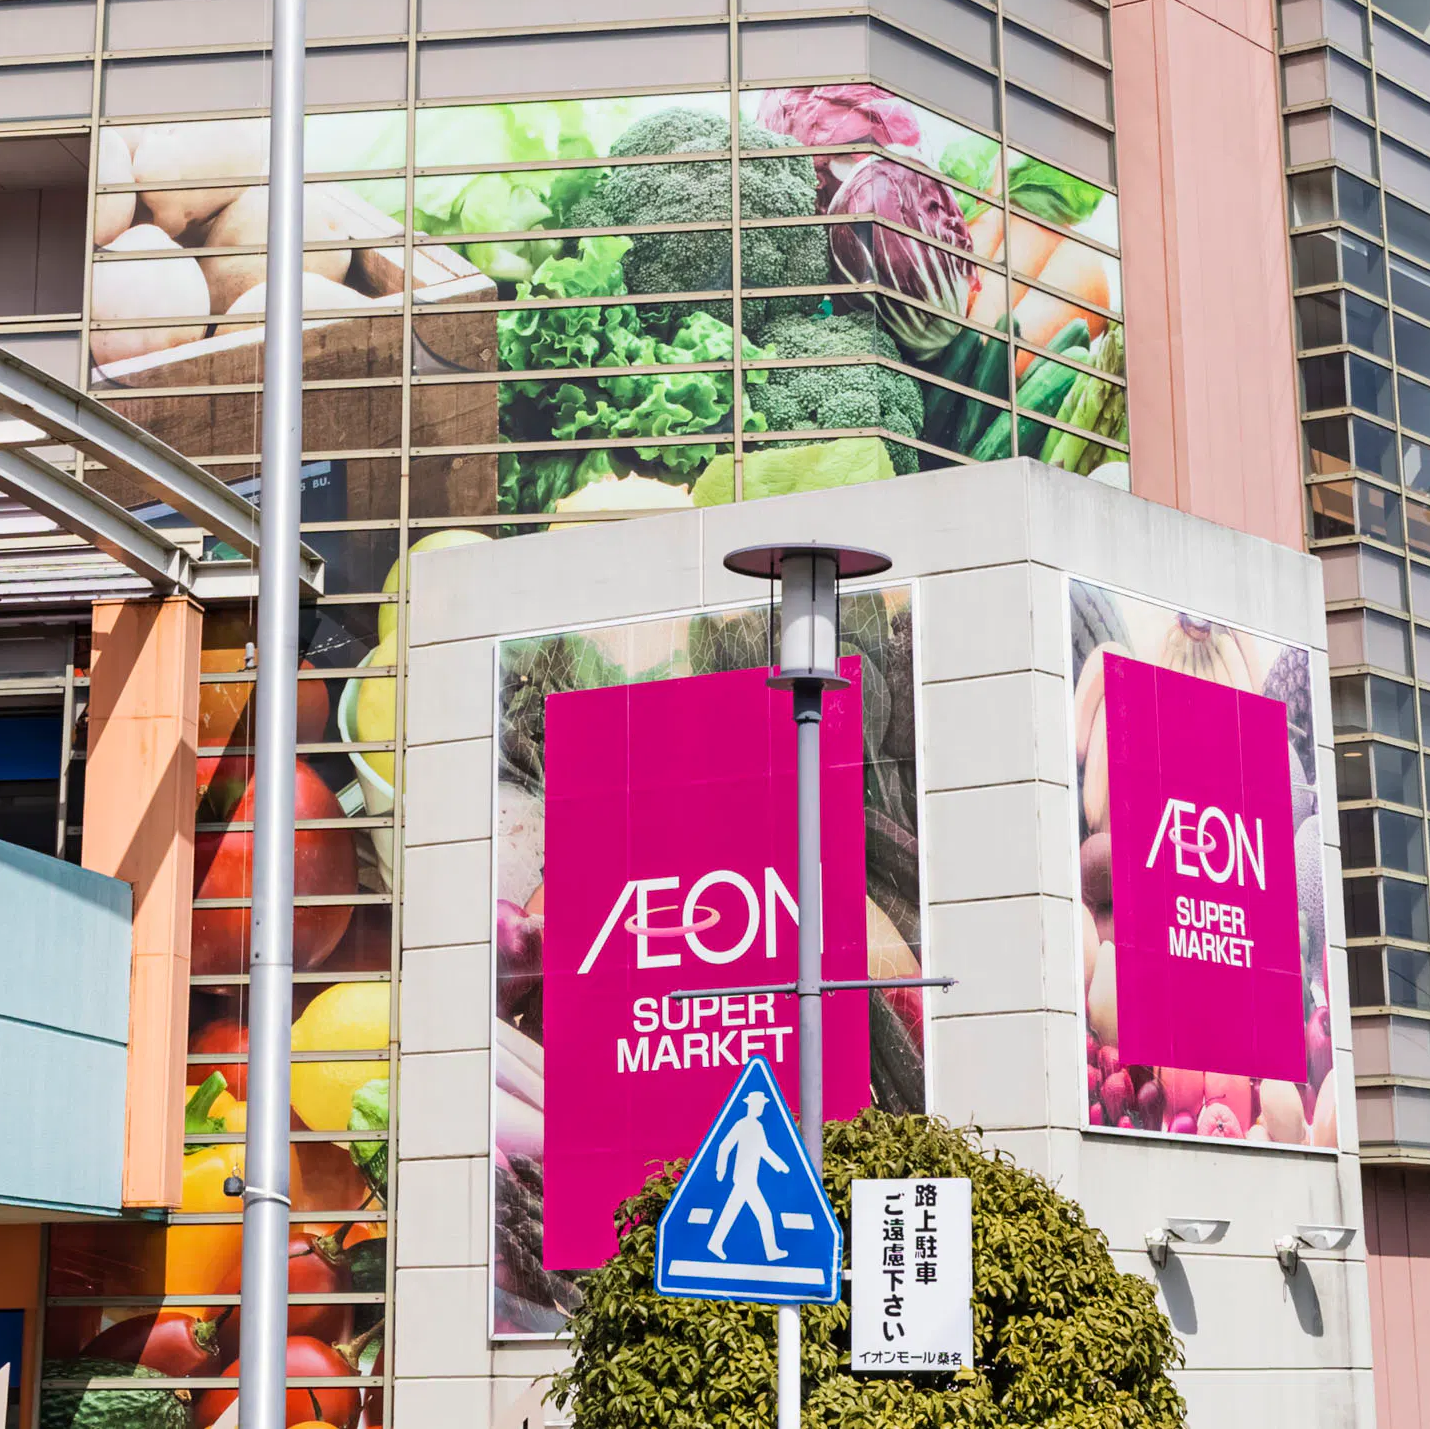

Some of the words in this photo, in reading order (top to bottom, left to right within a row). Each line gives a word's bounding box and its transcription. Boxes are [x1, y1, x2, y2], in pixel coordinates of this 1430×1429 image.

[1175, 895, 1246, 936] SUPER
[1168, 926, 1255, 969] MARKET
[633, 992, 775, 1033] SUPER
[616, 1026, 793, 1073] MARKET
[914, 1183, 938, 1286] 路上駐車
[882, 1192, 905, 1342] ご遠慮下さい
[858, 1350, 963, 1366] イオンモール桑名
